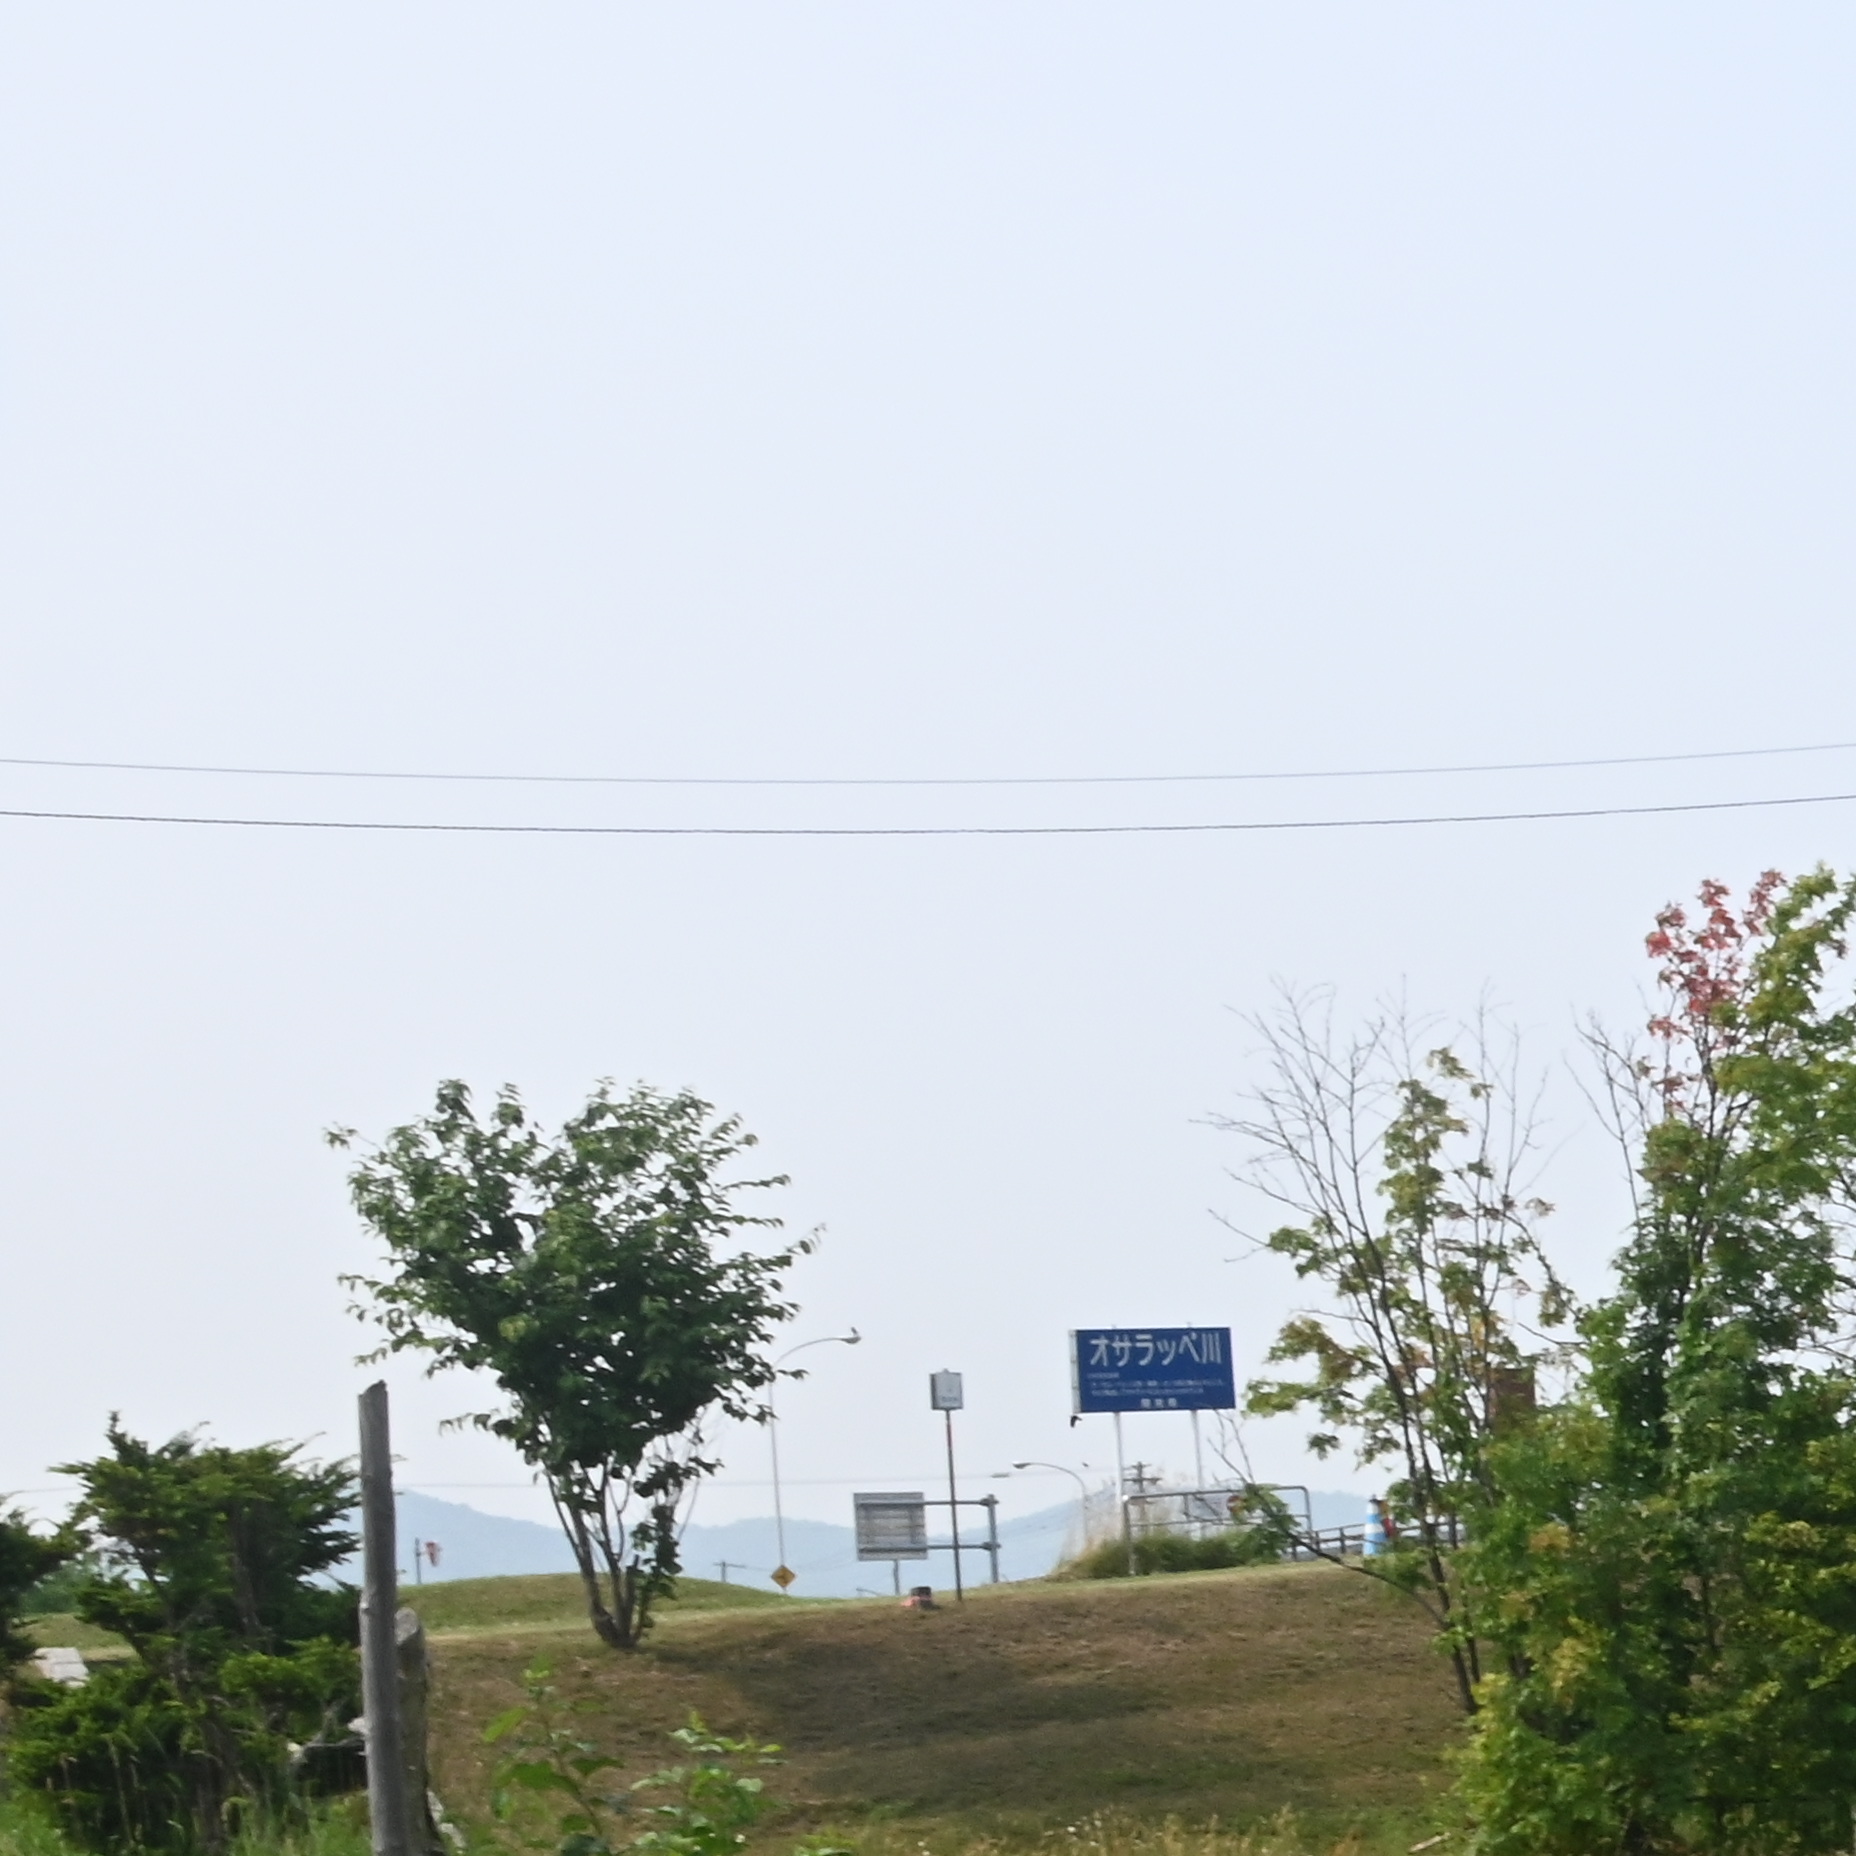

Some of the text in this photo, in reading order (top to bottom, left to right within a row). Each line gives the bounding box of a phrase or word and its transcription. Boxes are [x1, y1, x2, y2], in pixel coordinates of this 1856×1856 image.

[1089, 1332, 1222, 1367] オサラッペ川
